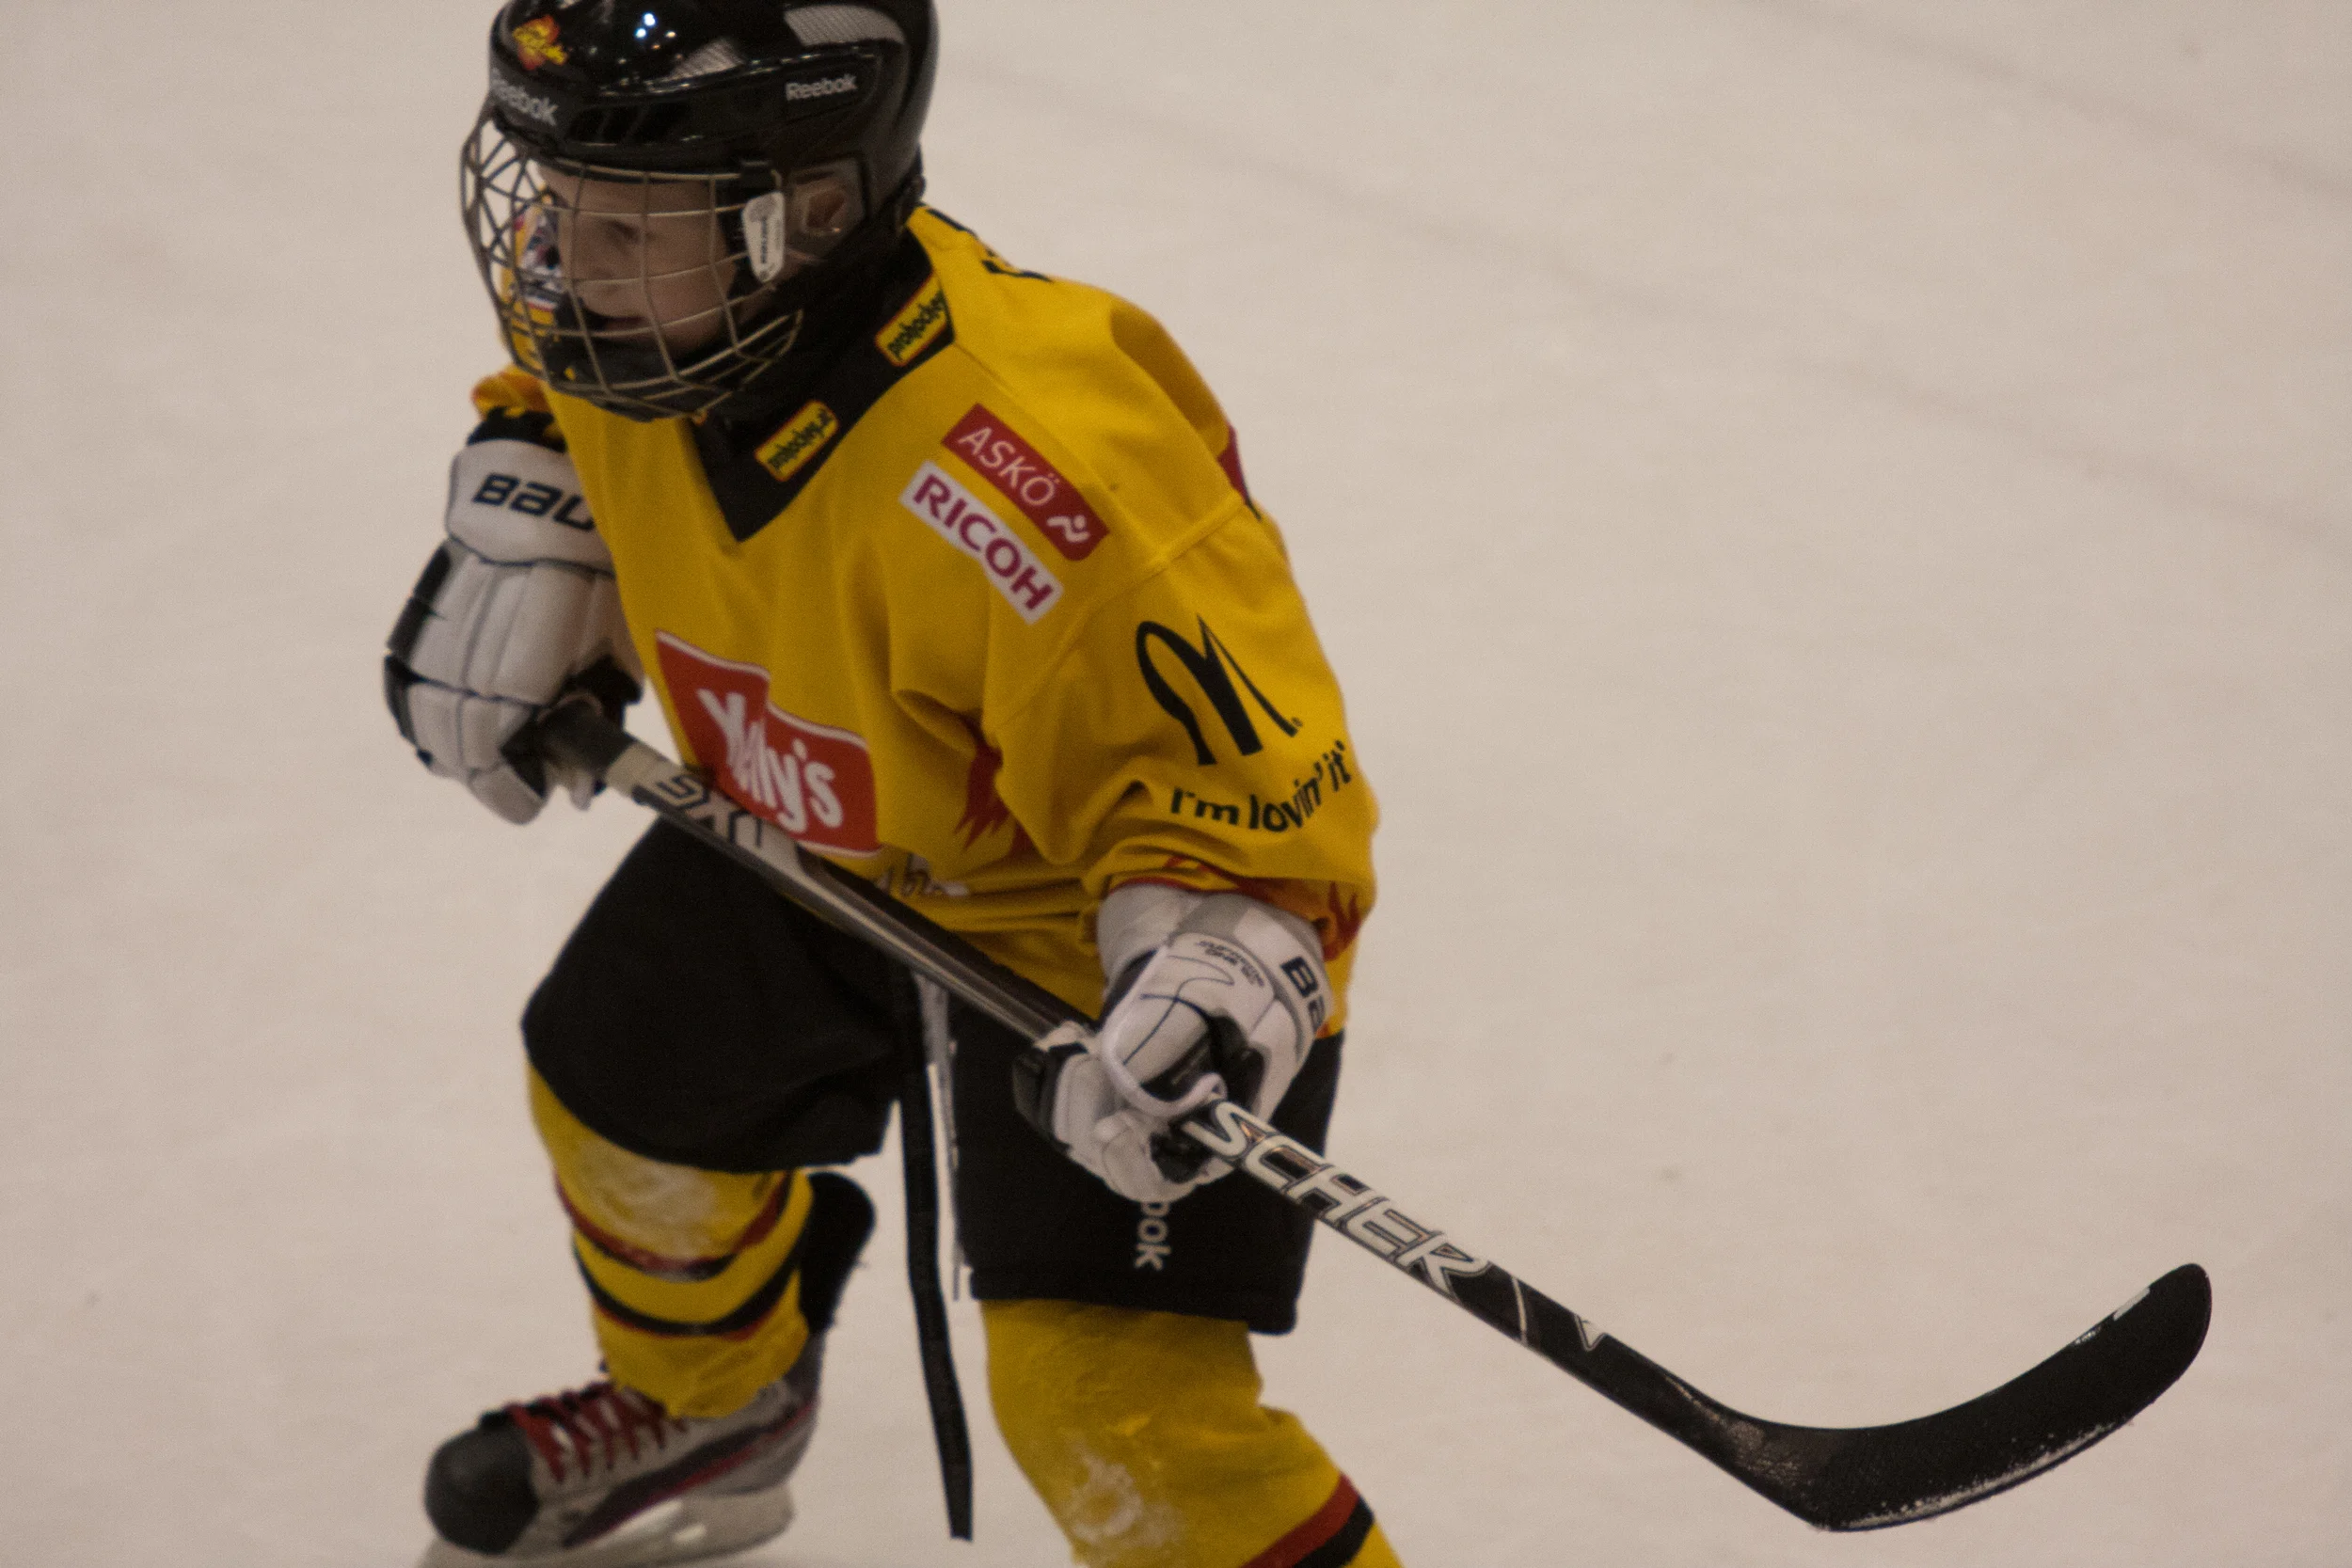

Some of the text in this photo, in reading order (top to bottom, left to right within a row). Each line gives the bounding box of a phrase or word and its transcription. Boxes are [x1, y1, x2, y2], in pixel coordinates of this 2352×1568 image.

[786, 74, 858, 101] Reebok
[958, 426, 1060, 506] ASKÖ
[913, 473, 1054, 610] RICOH
[1170, 739, 1352, 832] I'm lovin' it
